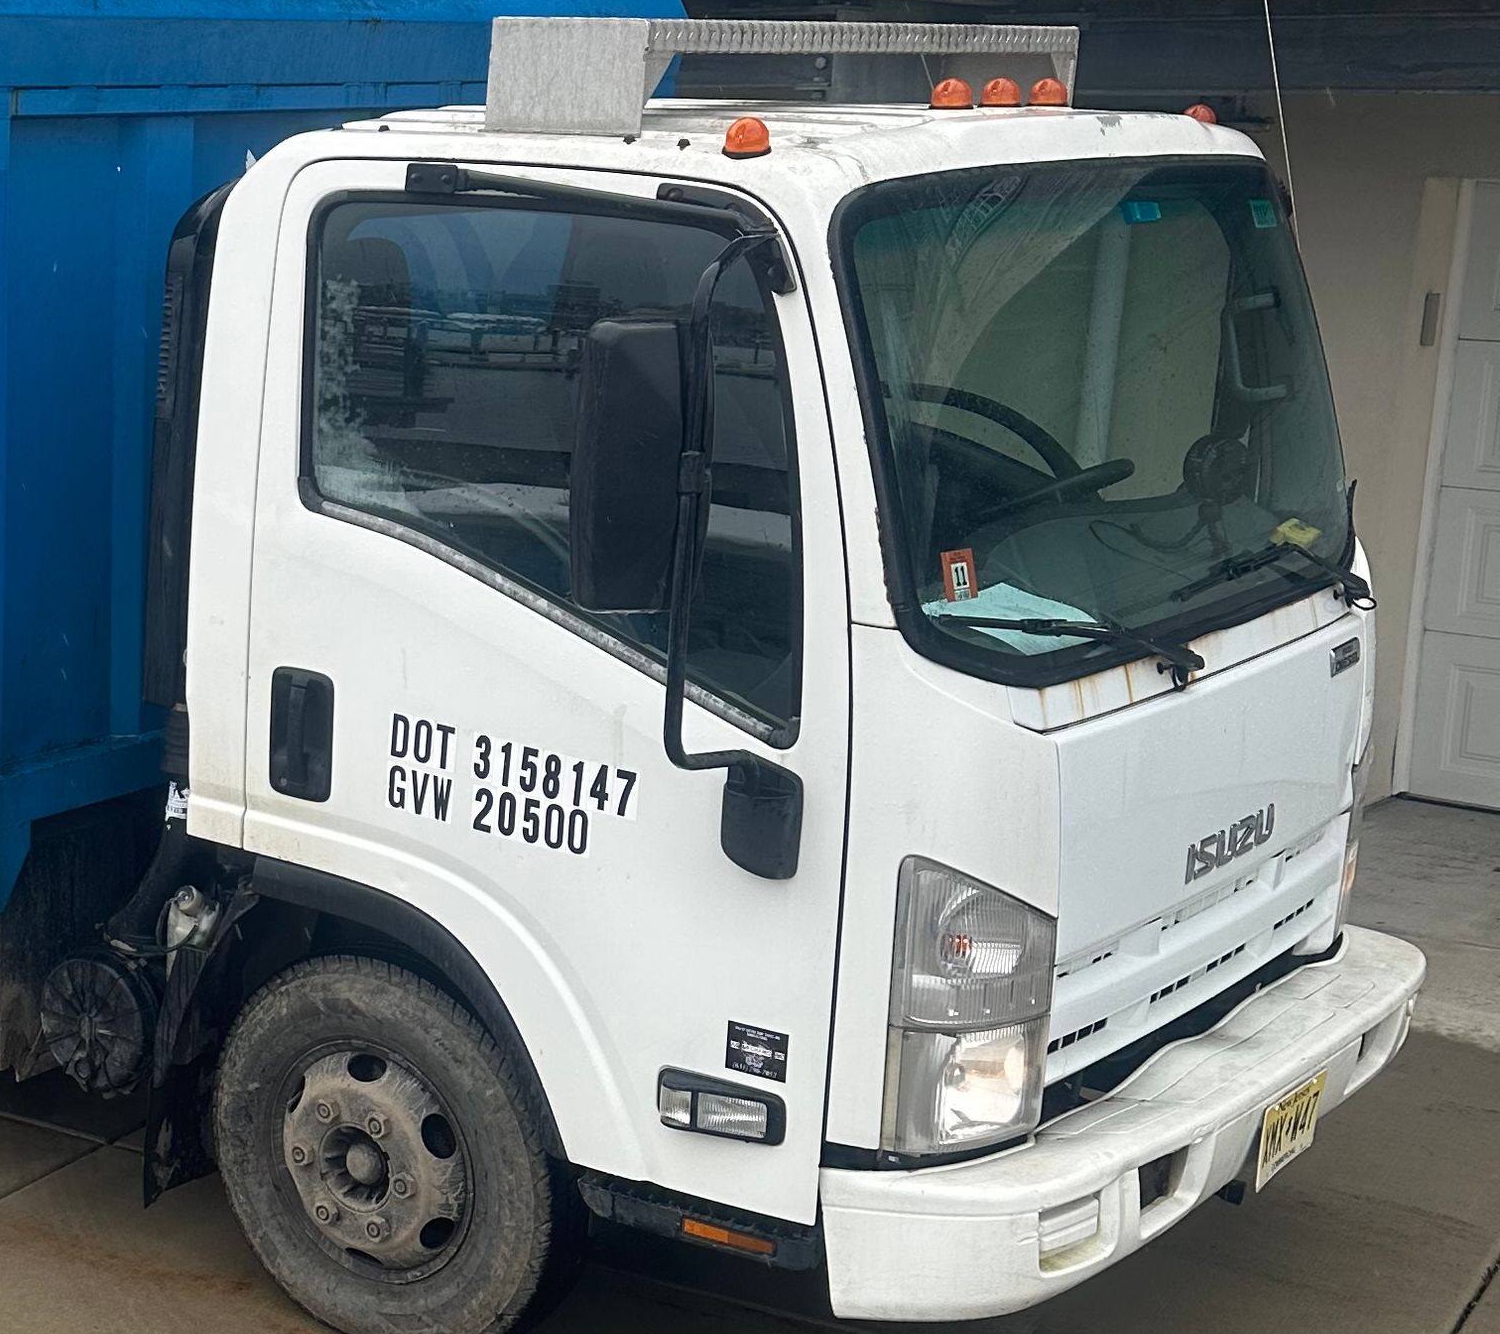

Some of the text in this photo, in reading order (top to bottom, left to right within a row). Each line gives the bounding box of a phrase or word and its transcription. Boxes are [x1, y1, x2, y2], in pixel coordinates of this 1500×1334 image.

[388, 765, 589, 855] GVW 20500
[390, 713, 637, 817] DOT 3158147
[1185, 803, 1275, 884] ISUZU
